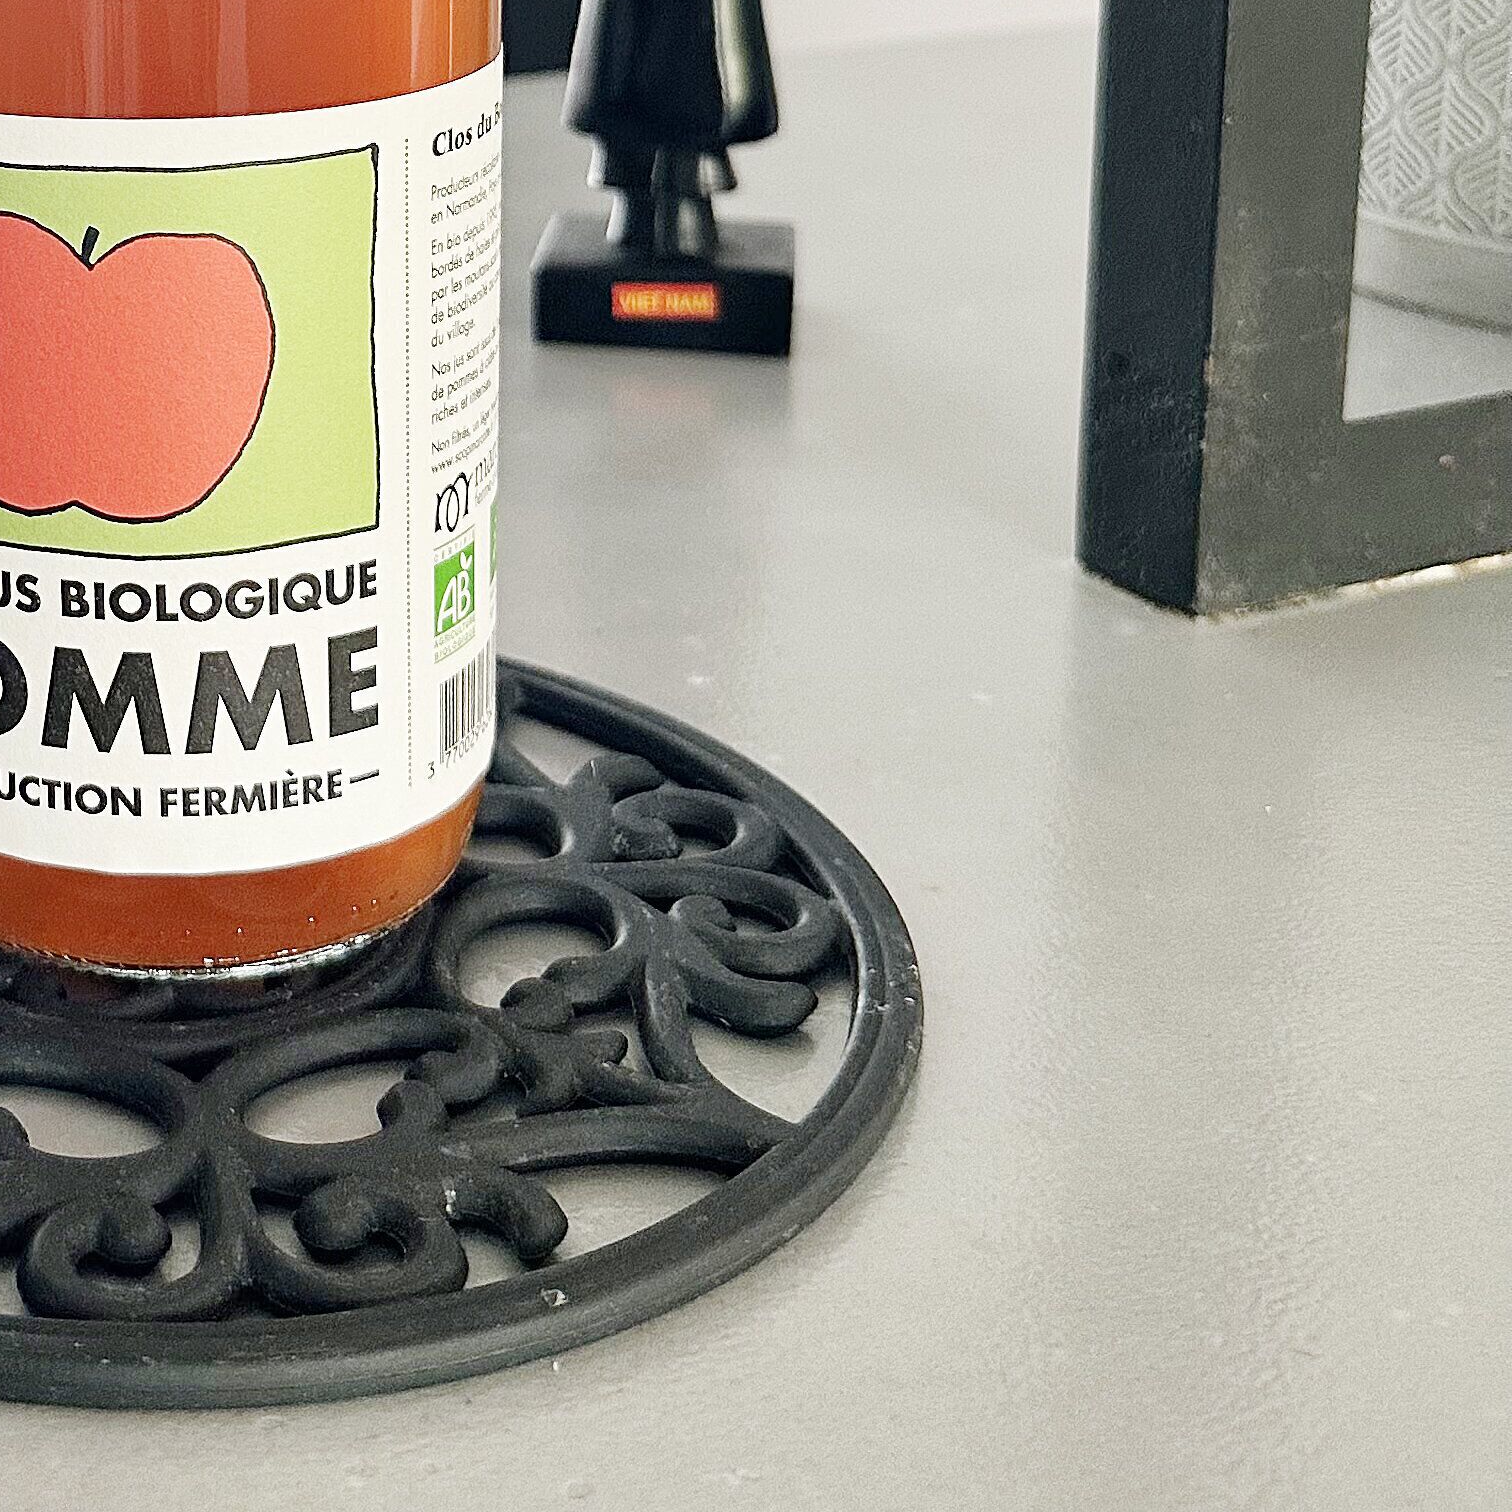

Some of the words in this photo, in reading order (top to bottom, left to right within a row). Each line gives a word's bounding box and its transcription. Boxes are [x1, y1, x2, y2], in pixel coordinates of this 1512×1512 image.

[432, 126, 472, 156] Clos
[477, 113, 492, 140] du
[430, 211, 443, 225] en
[431, 238, 443, 256] En
[447, 232, 461, 250] bio
[431, 285, 448, 307] par
[451, 276, 462, 293] les
[431, 306, 444, 324] de
[431, 328, 444, 348] du
[431, 360, 451, 380] Nos
[453, 354, 465, 374] jus
[431, 384, 444, 402] de
[431, 402, 458, 426] riches
[431, 436, 450, 456] Non
[61, 559, 377, 621] BIOLOGIQUE
[436, 569, 471, 633] AB
